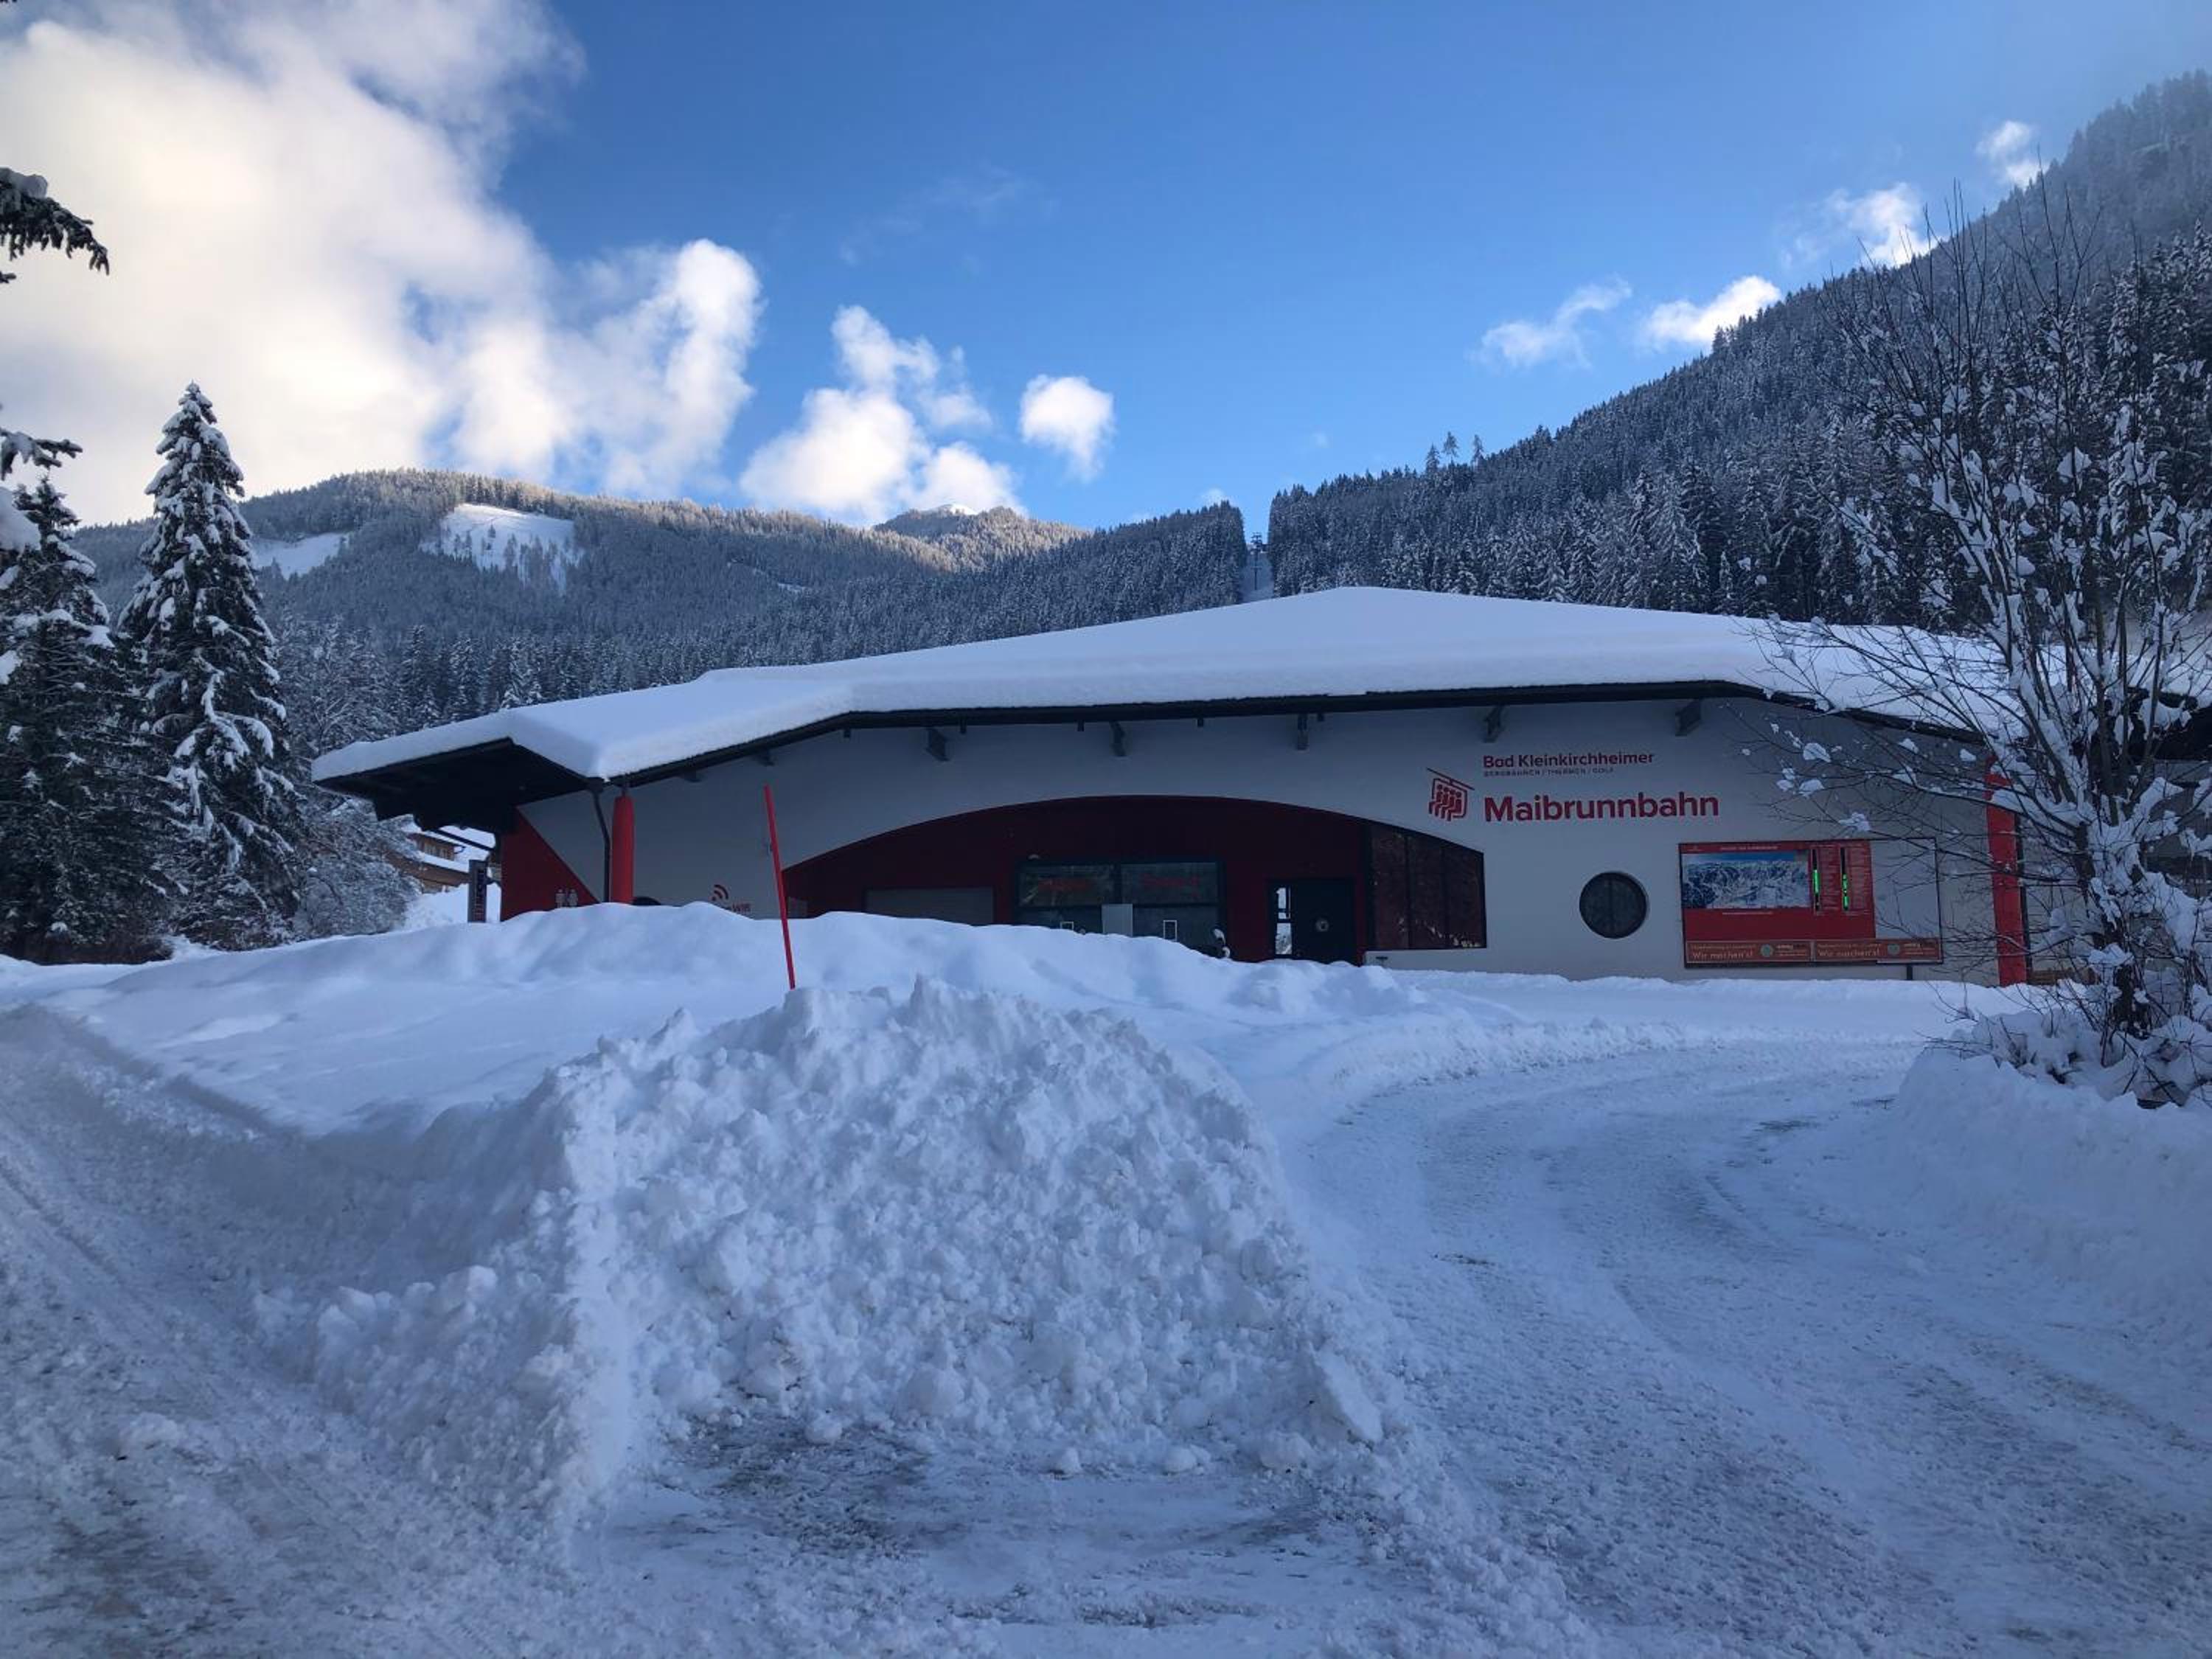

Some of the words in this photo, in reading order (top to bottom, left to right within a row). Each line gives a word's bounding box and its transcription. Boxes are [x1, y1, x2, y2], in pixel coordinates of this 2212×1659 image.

[1483, 754, 1514, 768] Bad
[1518, 751, 1654, 768] Kleinkirchheimer
[1484, 791, 1719, 822] Maibrunnbahn
